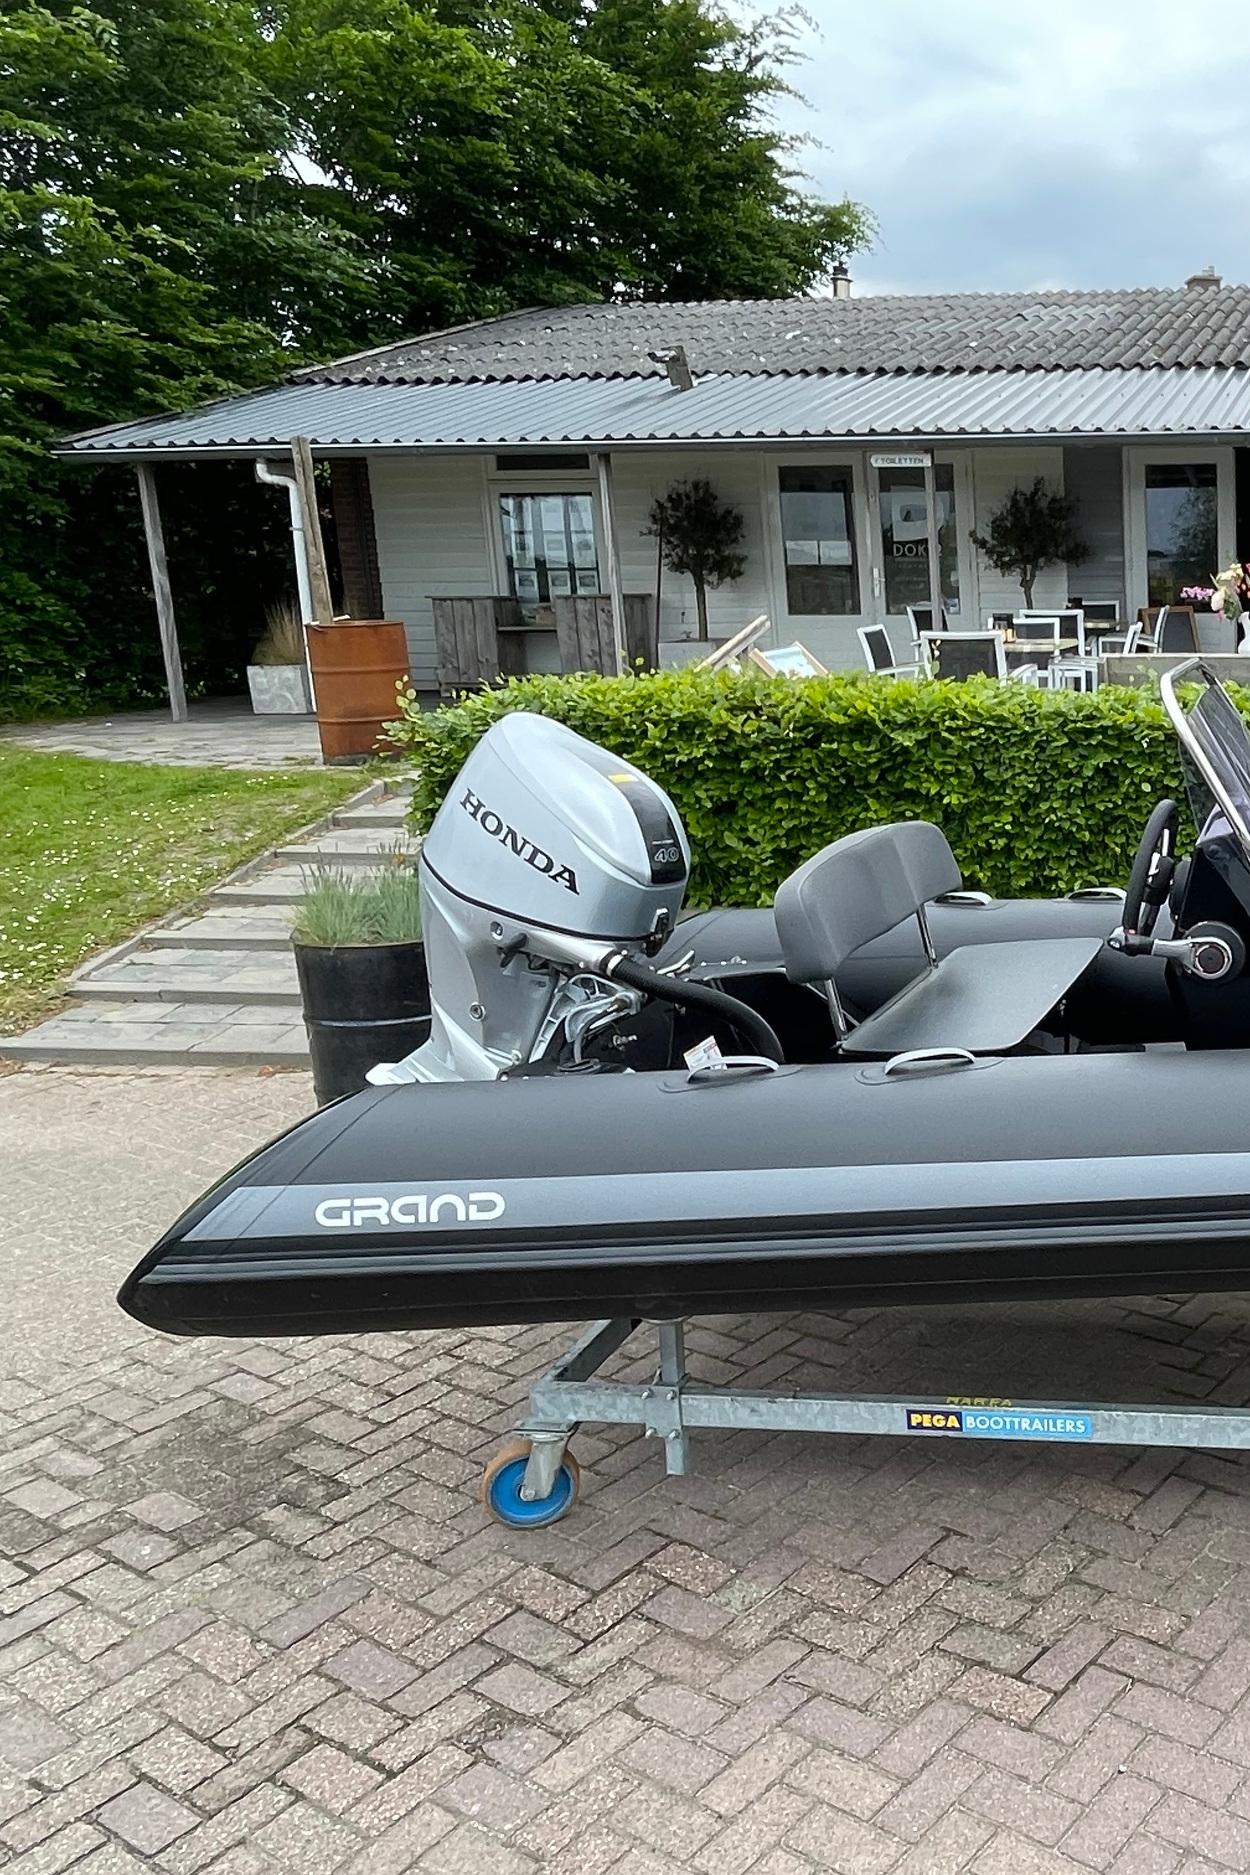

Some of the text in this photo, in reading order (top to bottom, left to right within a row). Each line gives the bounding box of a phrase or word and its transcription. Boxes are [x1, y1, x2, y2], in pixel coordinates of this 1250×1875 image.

[460, 788, 580, 895] HONDA
[654, 847, 680, 863] 40
[315, 1191, 506, 1227] GRAND
[910, 1413, 1086, 1433] PEGA BOOTTRAILERS
